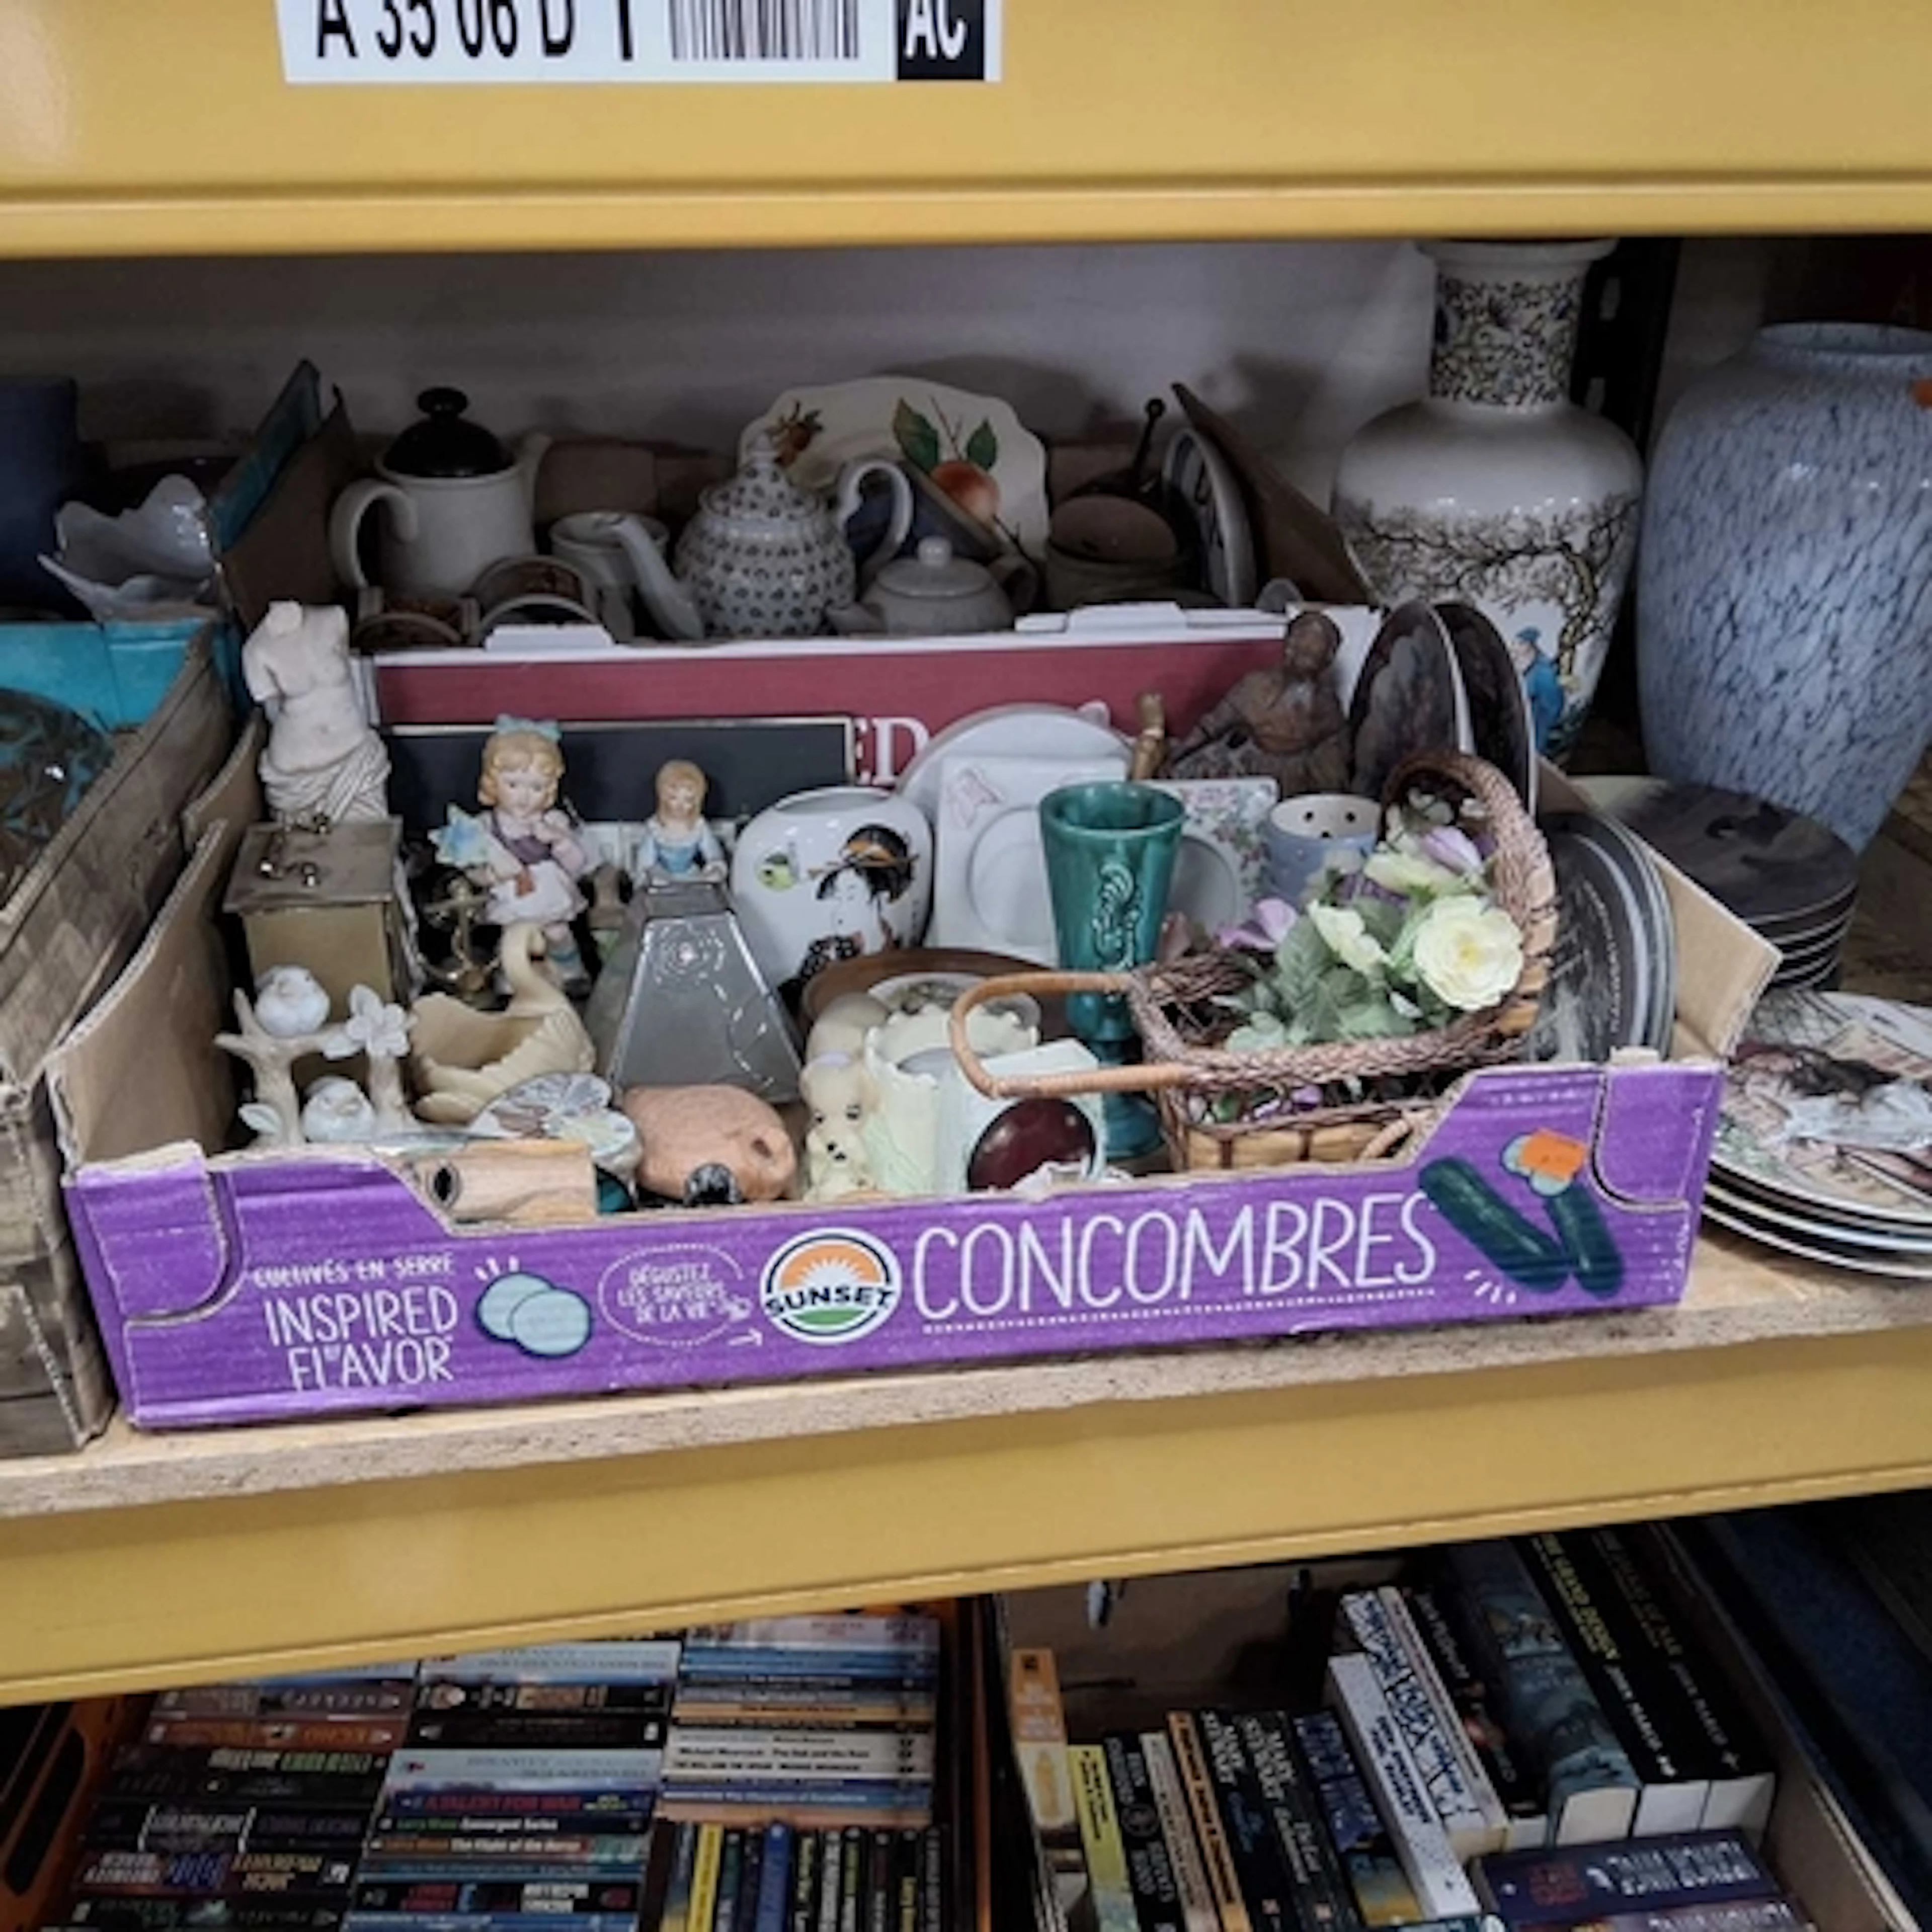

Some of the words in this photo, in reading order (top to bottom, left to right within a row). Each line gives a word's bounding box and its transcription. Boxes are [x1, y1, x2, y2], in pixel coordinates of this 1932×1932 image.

[317, 0, 359, 57] A
[356, 1258, 385, 1280] EN
[914, 1191, 1437, 1320] CONCOMBRES
[264, 1285, 458, 1347] INSPIRED
[765, 1285, 894, 1318] SUNSET
